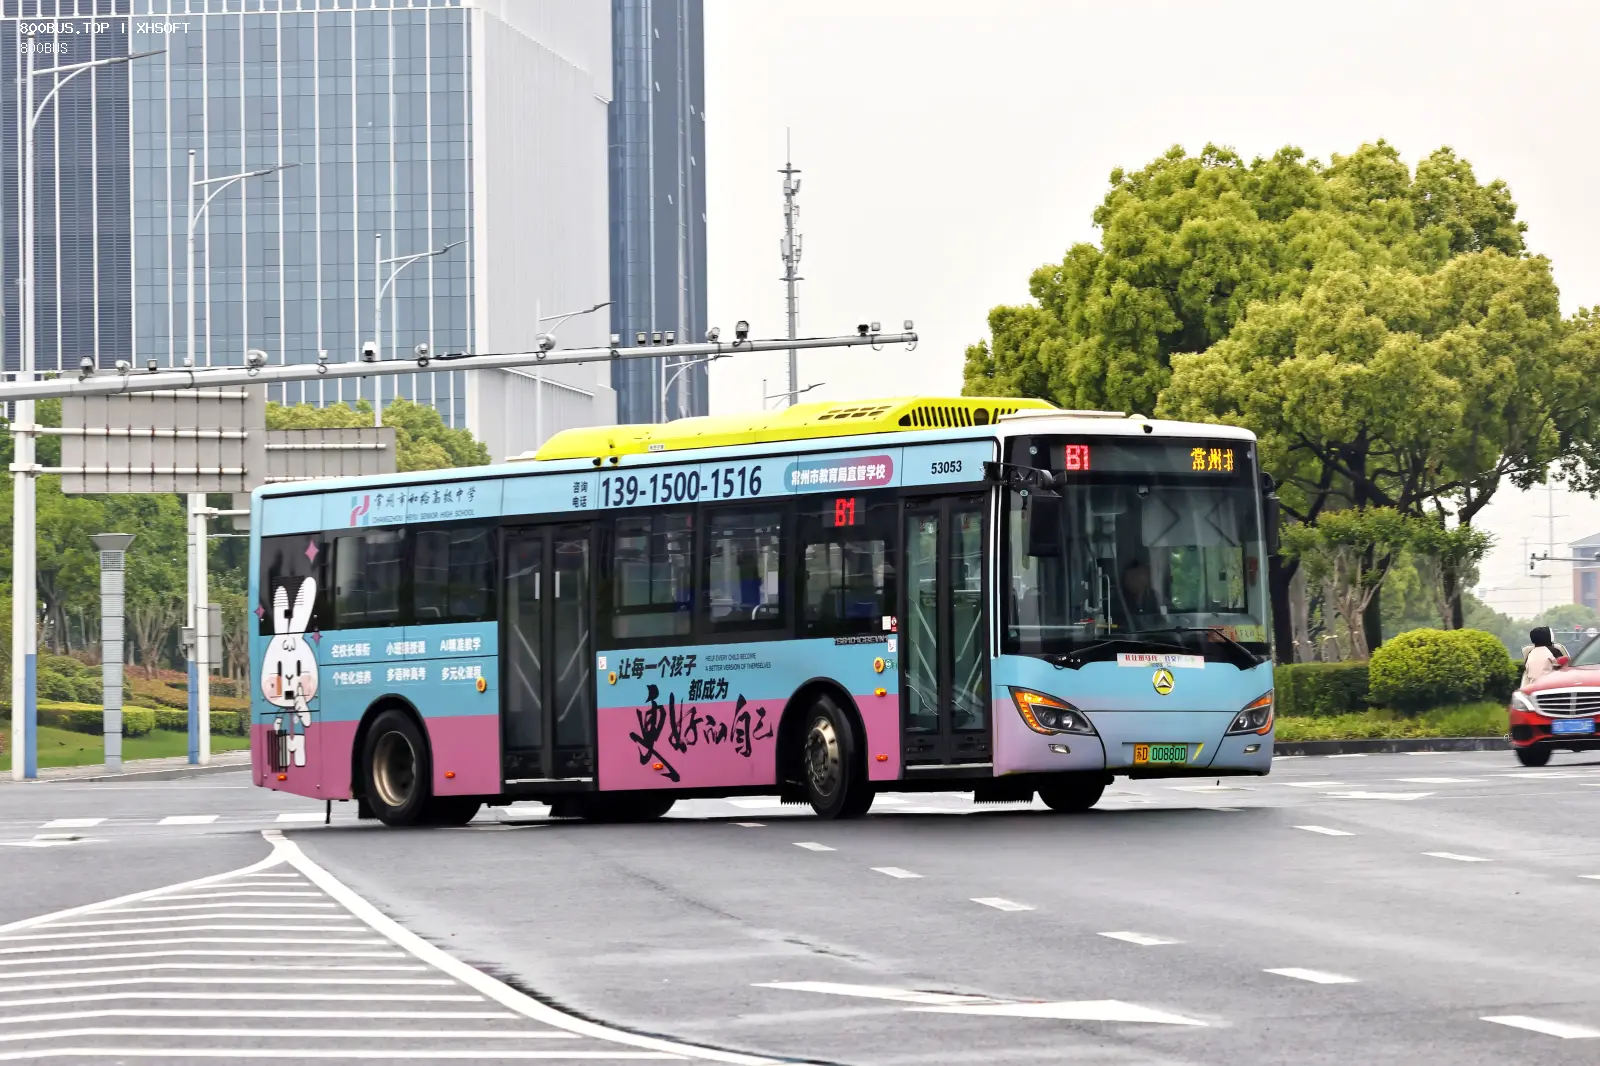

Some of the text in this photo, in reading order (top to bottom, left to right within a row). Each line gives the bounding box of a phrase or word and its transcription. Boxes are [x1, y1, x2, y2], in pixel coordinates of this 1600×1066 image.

[930, 460, 963, 475] 53053
[1065, 444, 1089, 470] B1
[601, 465, 762, 507] 139-1500-1516
[791, 463, 886, 486] 常州市教育局直管学校
[455, 508, 475, 517] SCHOOL
[572, 495, 587, 508] 电话
[834, 498, 855, 527] B1
[618, 654, 697, 680] 让每一个孩子
[723, 663, 741, 671] VERSION
[747, 661, 772, 669] THEMSELVES
[688, 677, 729, 701] 都成为
[629, 684, 774, 782] 更好的自己
